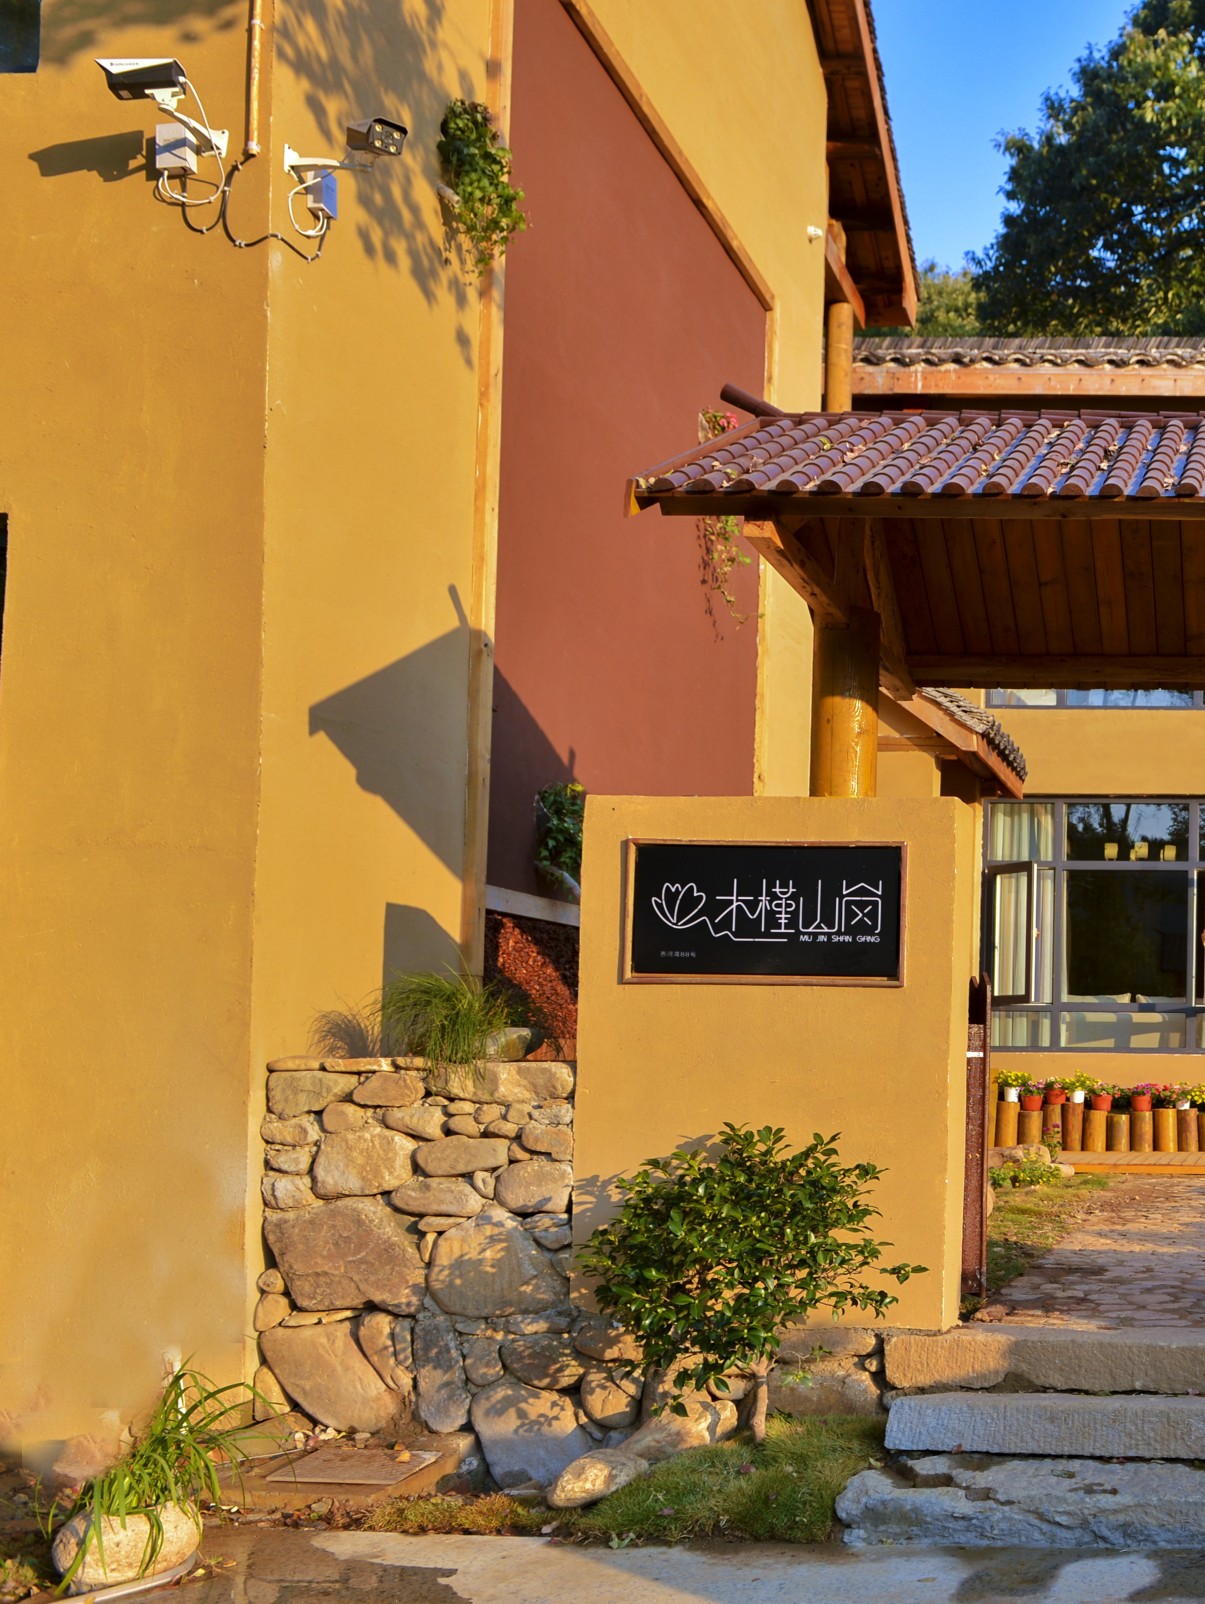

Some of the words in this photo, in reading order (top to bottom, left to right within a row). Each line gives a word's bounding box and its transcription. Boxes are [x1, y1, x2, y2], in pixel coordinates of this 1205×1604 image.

[715, 878, 883, 934] 木槿山岗
[856, 935, 880, 943] GANG
